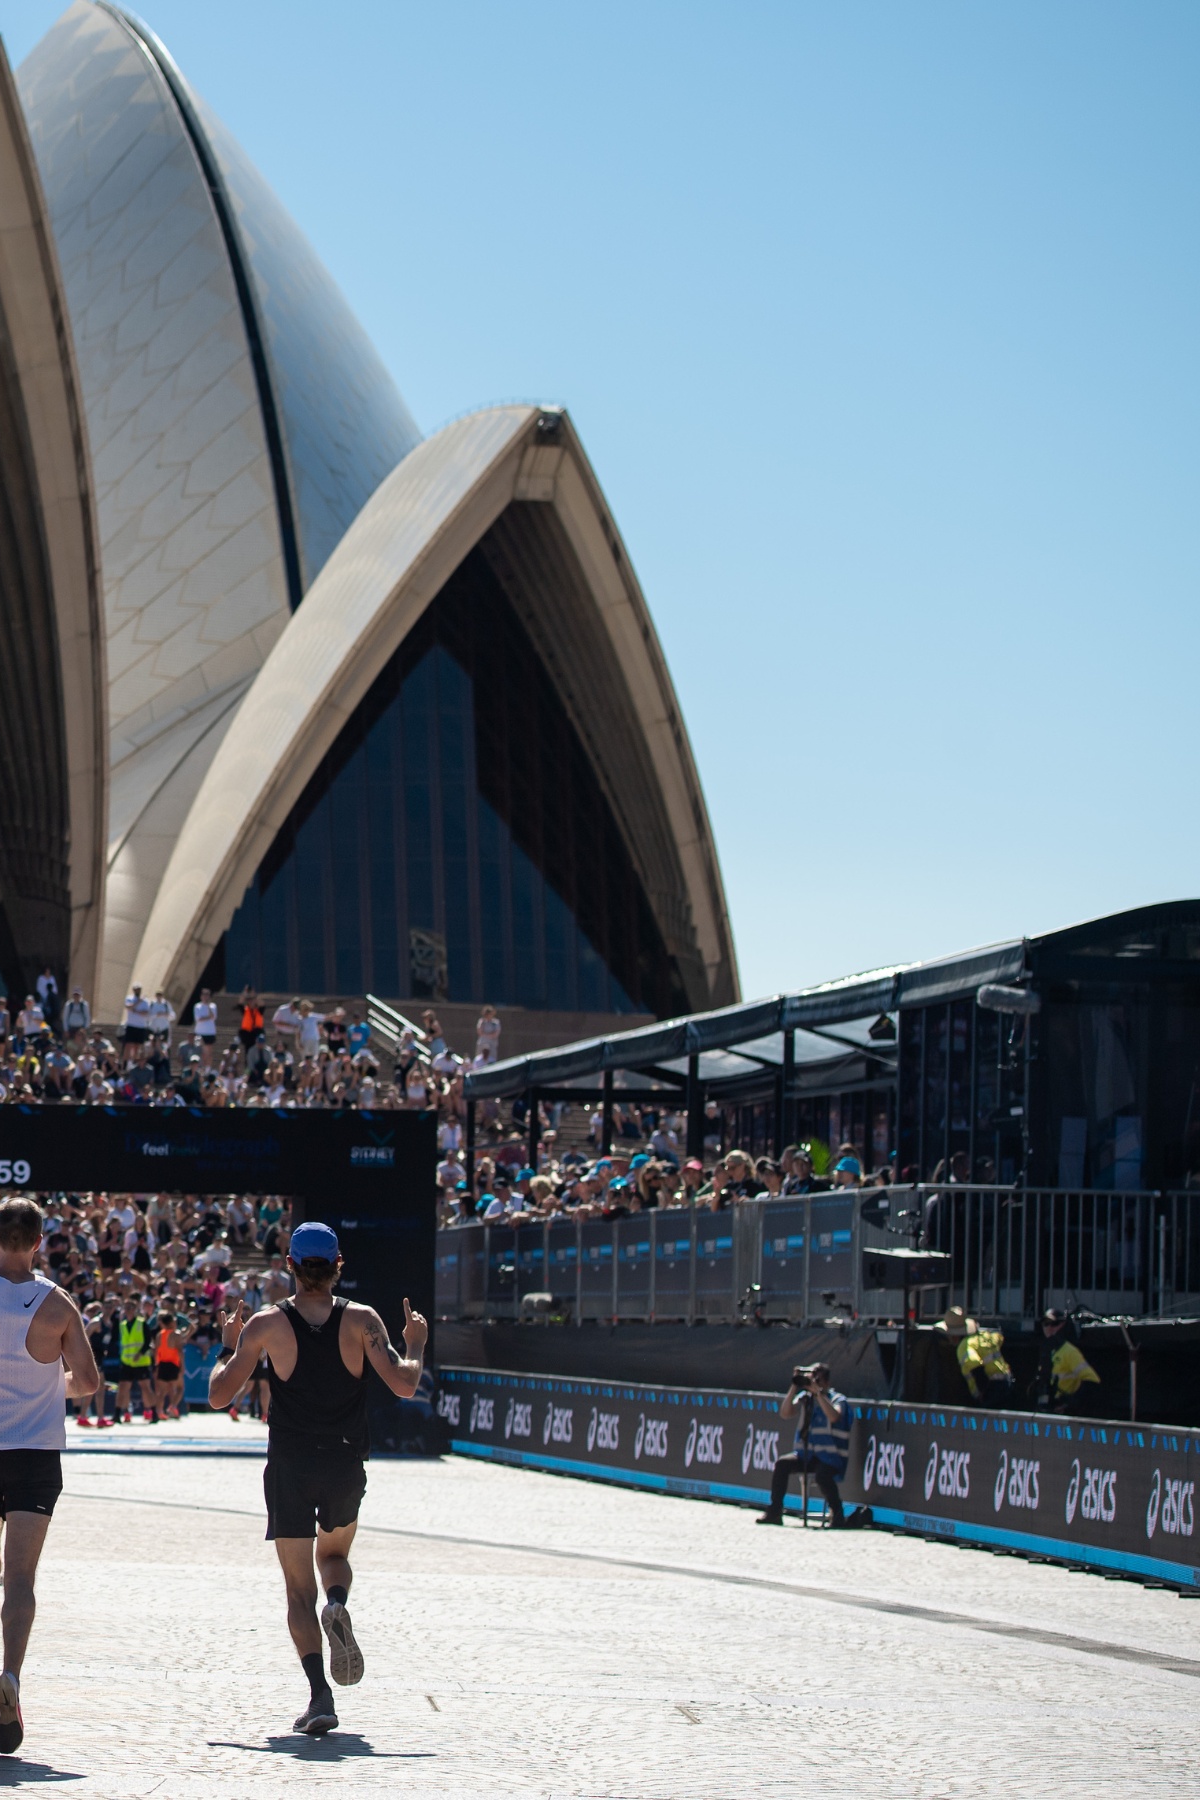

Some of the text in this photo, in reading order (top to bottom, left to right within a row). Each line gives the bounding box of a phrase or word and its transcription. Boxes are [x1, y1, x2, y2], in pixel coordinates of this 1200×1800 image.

[143, 1142, 169, 1156] feel
[644, 1419, 668, 1458] asics
[696, 1424, 723, 1464] asics
[753, 1429, 779, 1471] asics
[876, 1442, 905, 1488] asics
[938, 1450, 970, 1498] asics
[1008, 1457, 1040, 1510] asics
[1081, 1467, 1117, 1522] asics
[1161, 1477, 1195, 1536] asics
